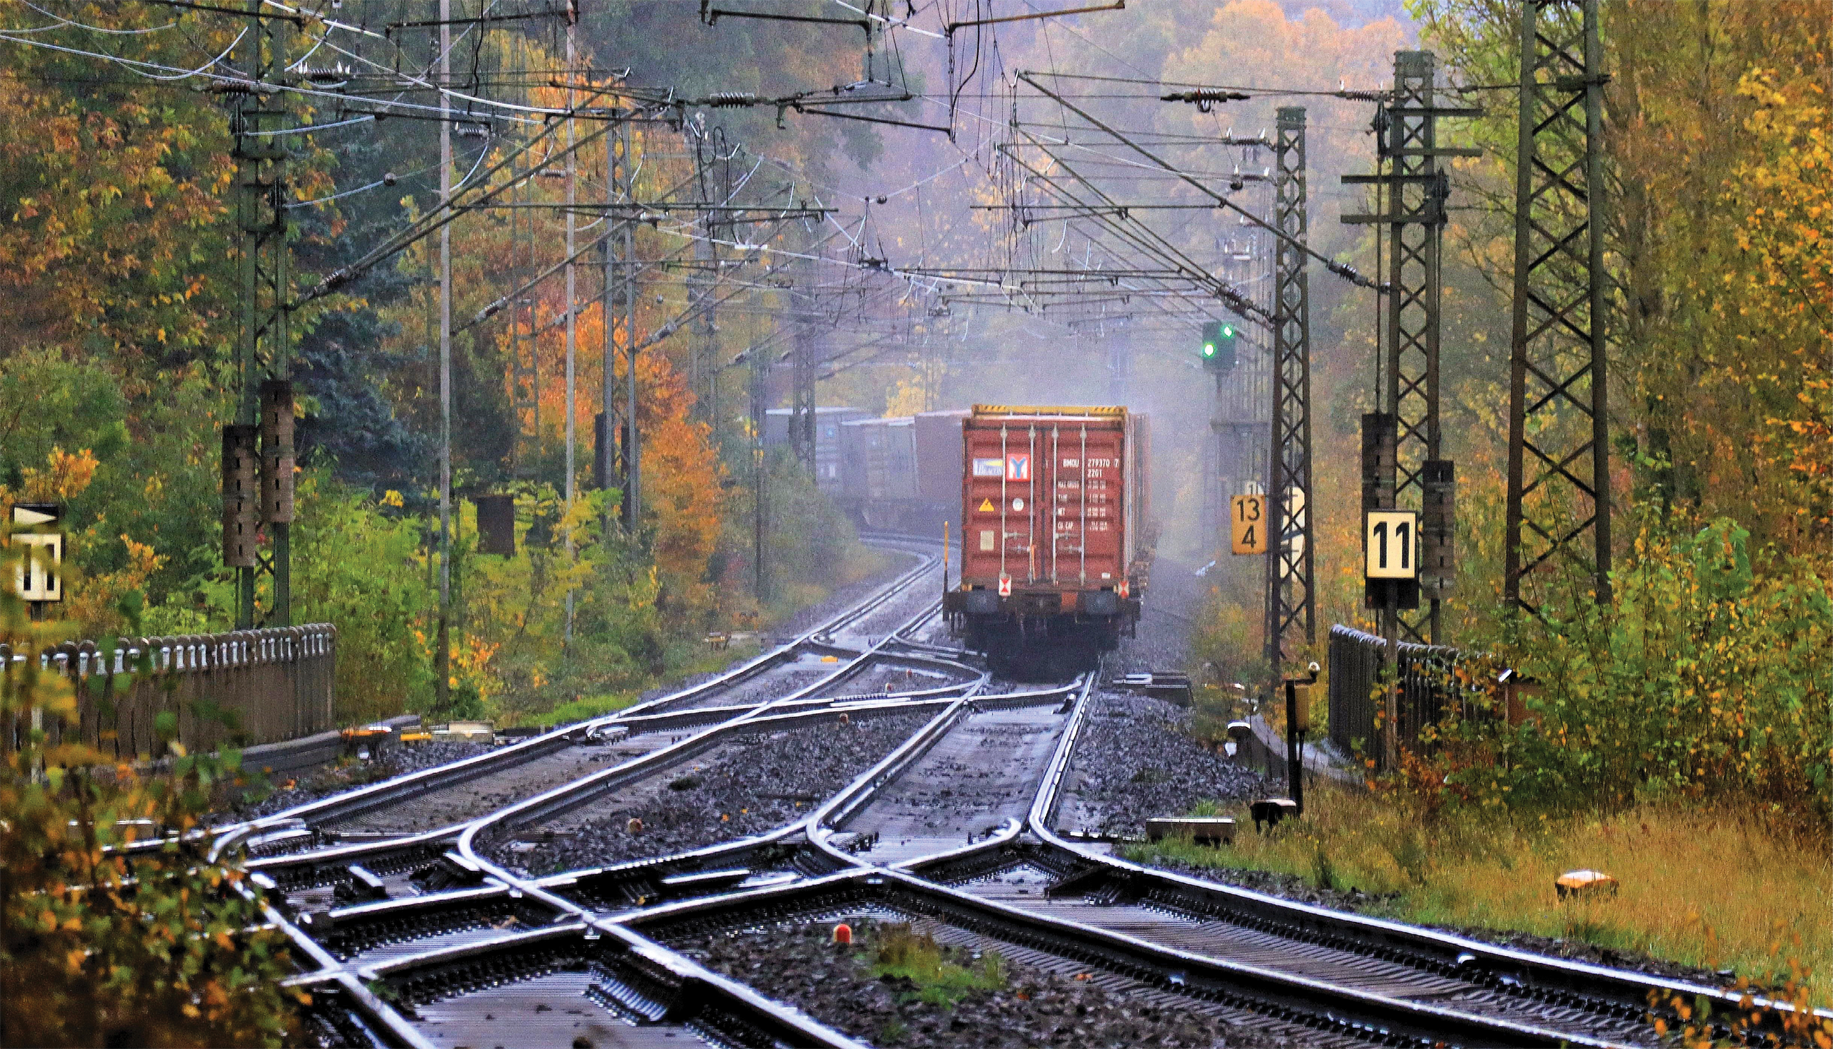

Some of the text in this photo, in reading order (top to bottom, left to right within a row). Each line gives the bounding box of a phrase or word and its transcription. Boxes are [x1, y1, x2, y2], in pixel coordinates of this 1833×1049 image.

[1087, 458, 1111, 468] 279370
[1237, 498, 1261, 522] 13
[1241, 525, 1257, 548] 4
[1373, 521, 1410, 569] 11
